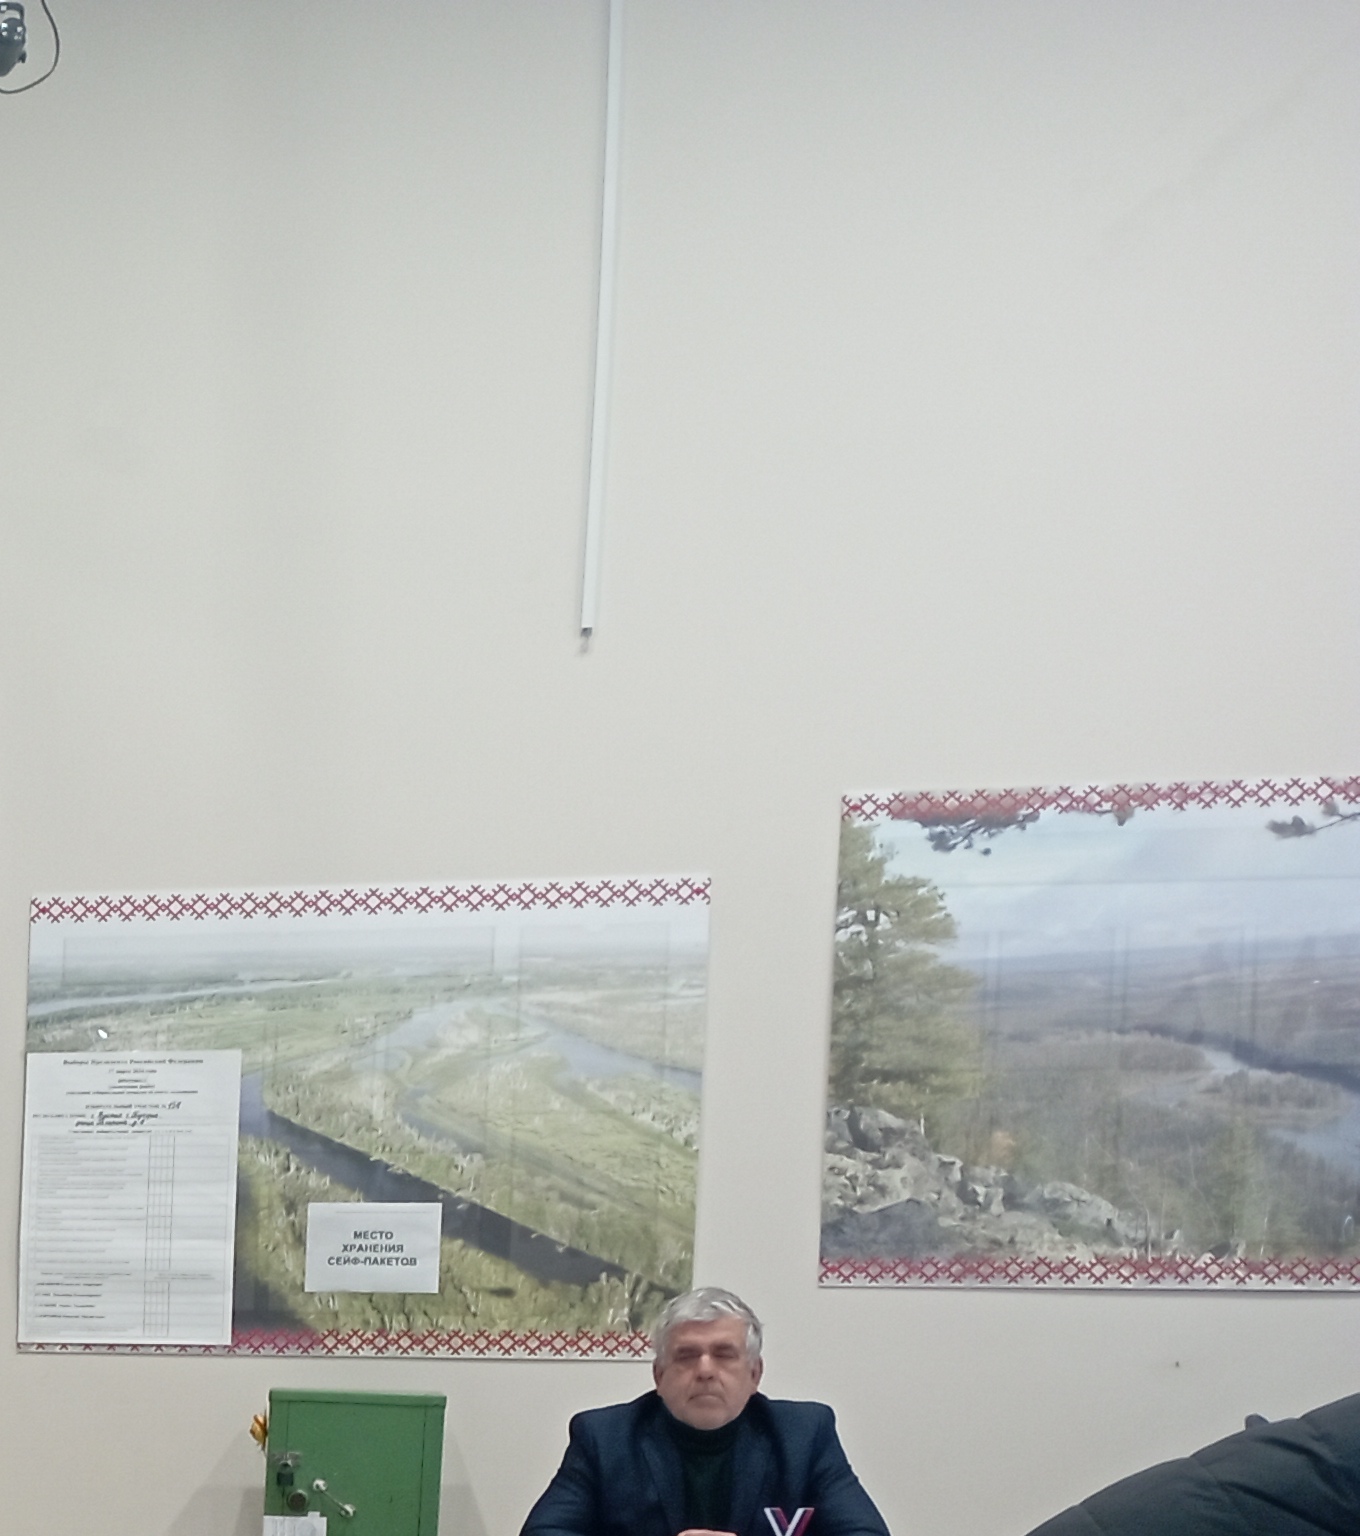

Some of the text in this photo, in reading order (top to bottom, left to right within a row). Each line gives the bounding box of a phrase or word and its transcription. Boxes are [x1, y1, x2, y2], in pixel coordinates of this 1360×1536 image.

[353, 1230, 394, 1240] МЕСТО
[341, 1244, 404, 1253] ХРАНЕНИЯ
[327, 1256, 418, 1266] СЕЙФ-ПАКЕТОВ
